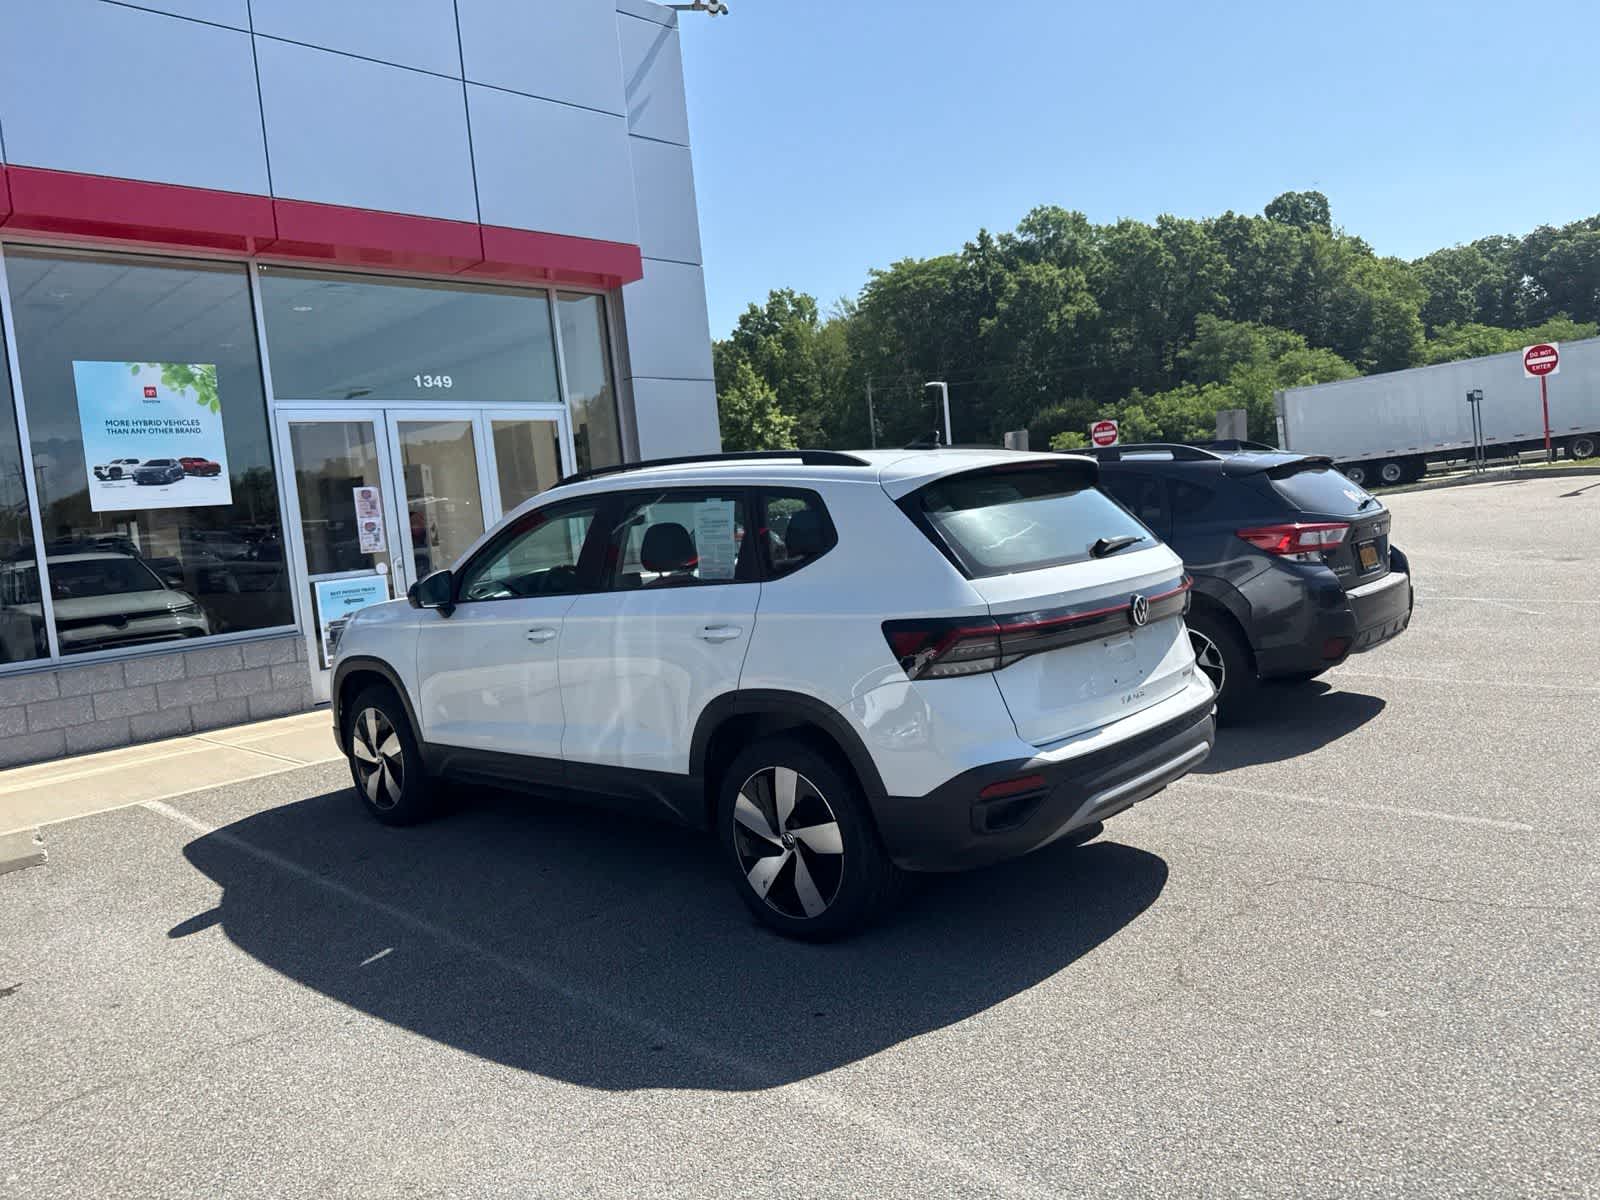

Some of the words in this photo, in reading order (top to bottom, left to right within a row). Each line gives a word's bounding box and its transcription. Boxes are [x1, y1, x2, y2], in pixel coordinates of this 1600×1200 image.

[413, 374, 453, 388] 1349
[105, 419, 130, 427] MORE
[132, 419, 162, 427] HYBRID
[163, 419, 201, 427] VEHICLES
[148, 427, 174, 435] OTHER
